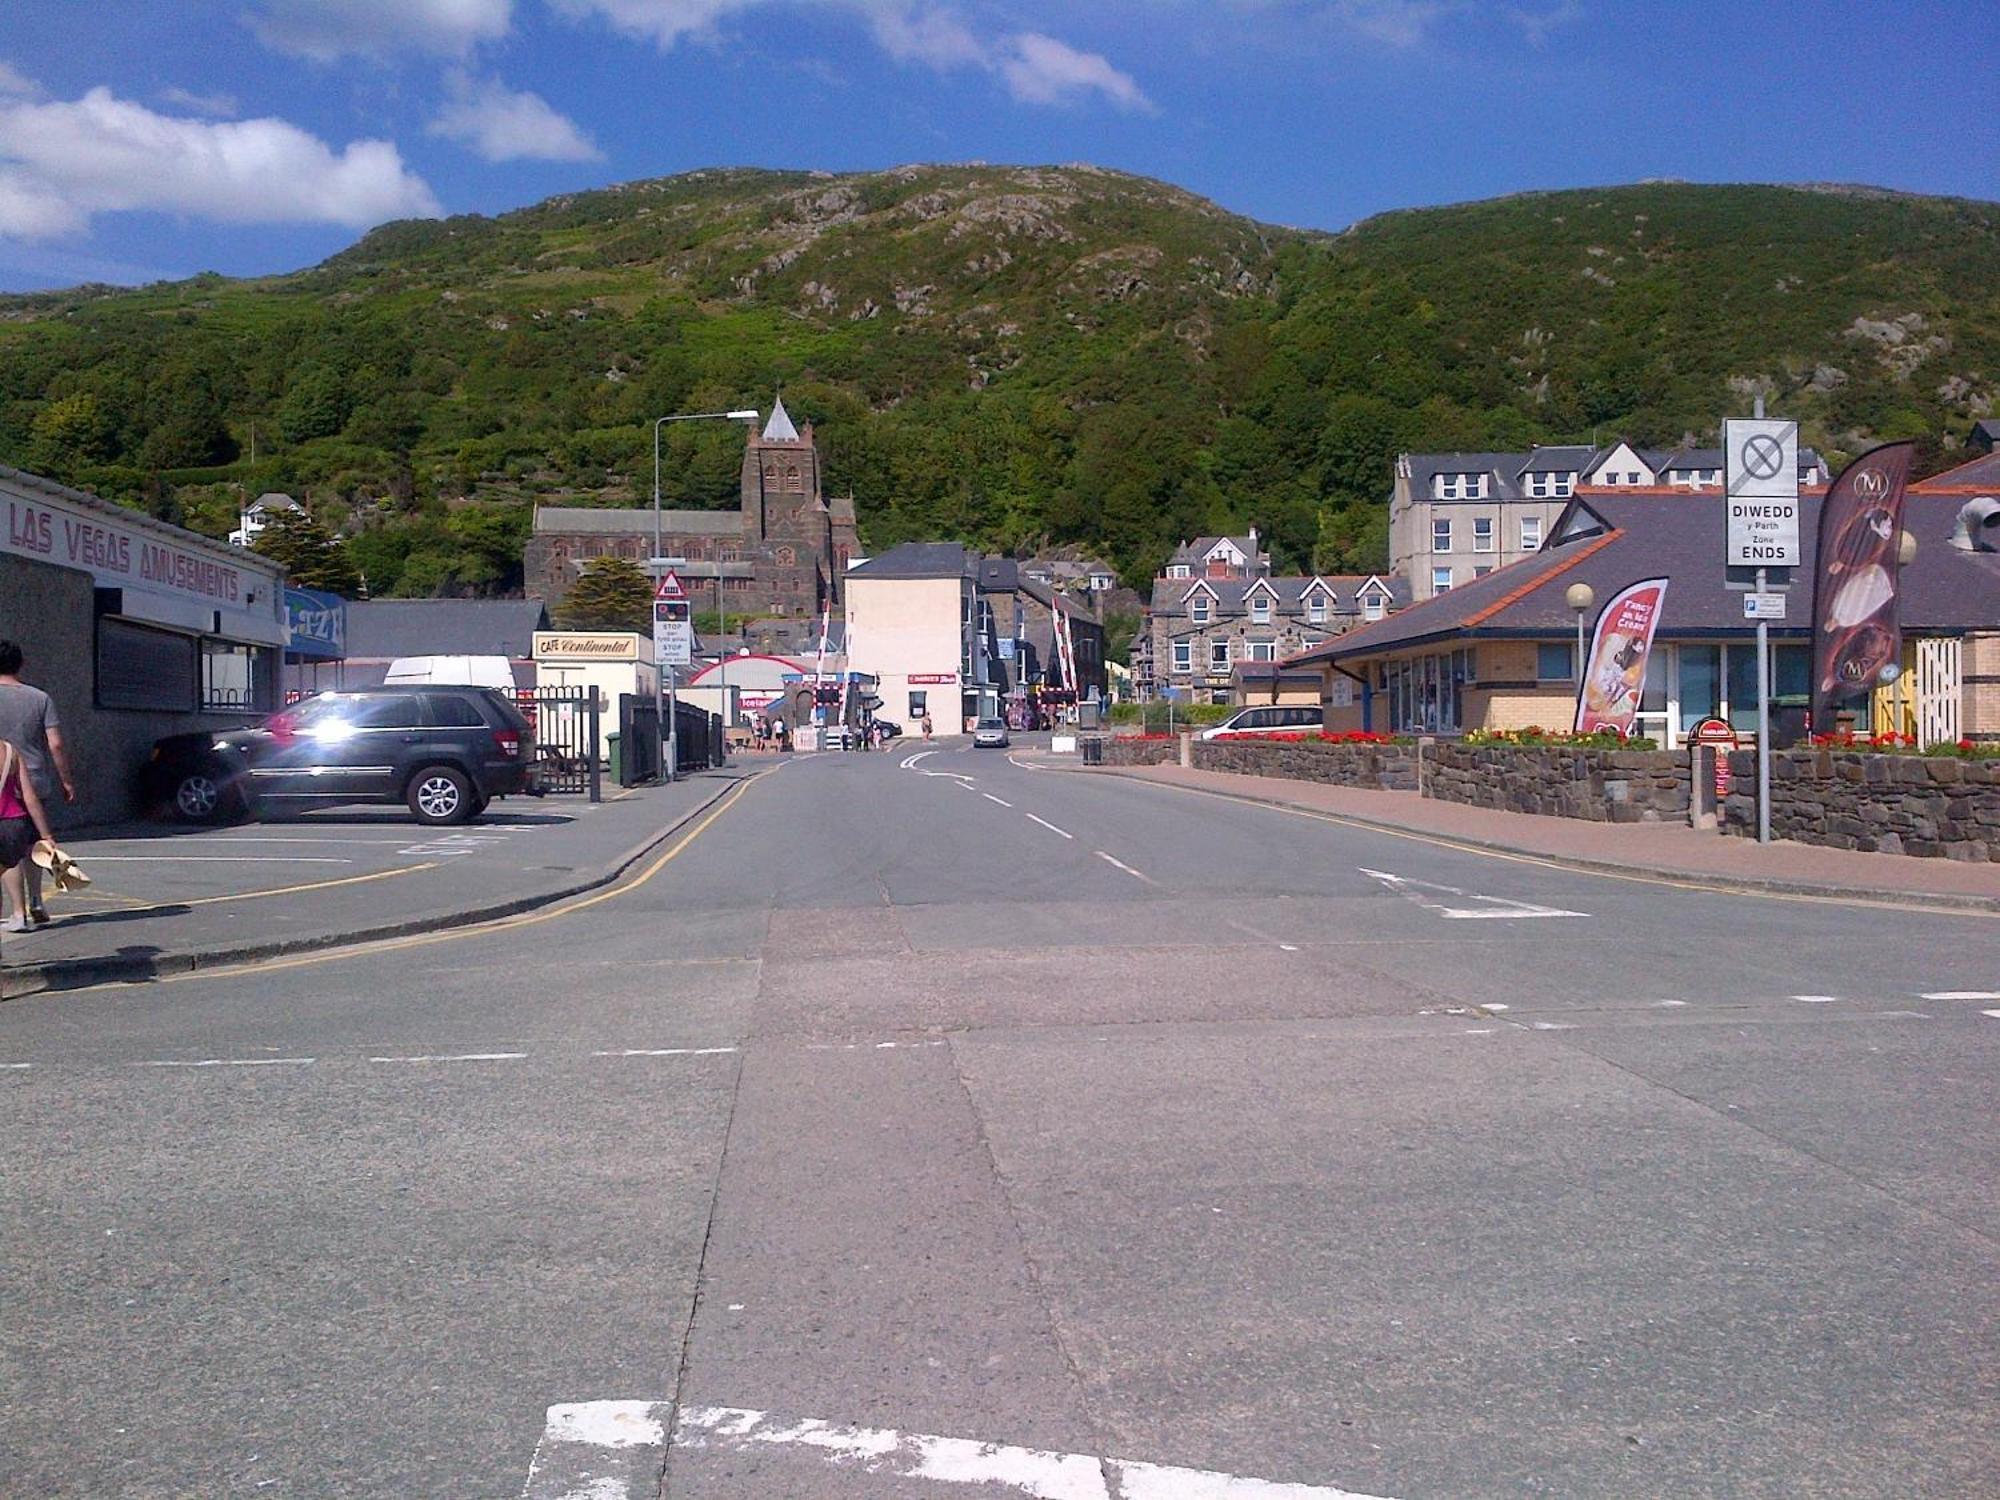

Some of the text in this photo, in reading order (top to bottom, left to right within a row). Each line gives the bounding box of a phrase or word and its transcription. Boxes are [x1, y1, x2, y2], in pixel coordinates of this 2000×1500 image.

[1733, 505, 1793, 518] DIWEDD
[1747, 521, 1779, 531] y Parth
[1752, 535, 1774, 544] Zone
[10, 503, 239, 602] LAS VEGAS AMUSEMENTS
[1742, 546, 1785, 558] ENDS
[562, 640, 631, 653] Continental
